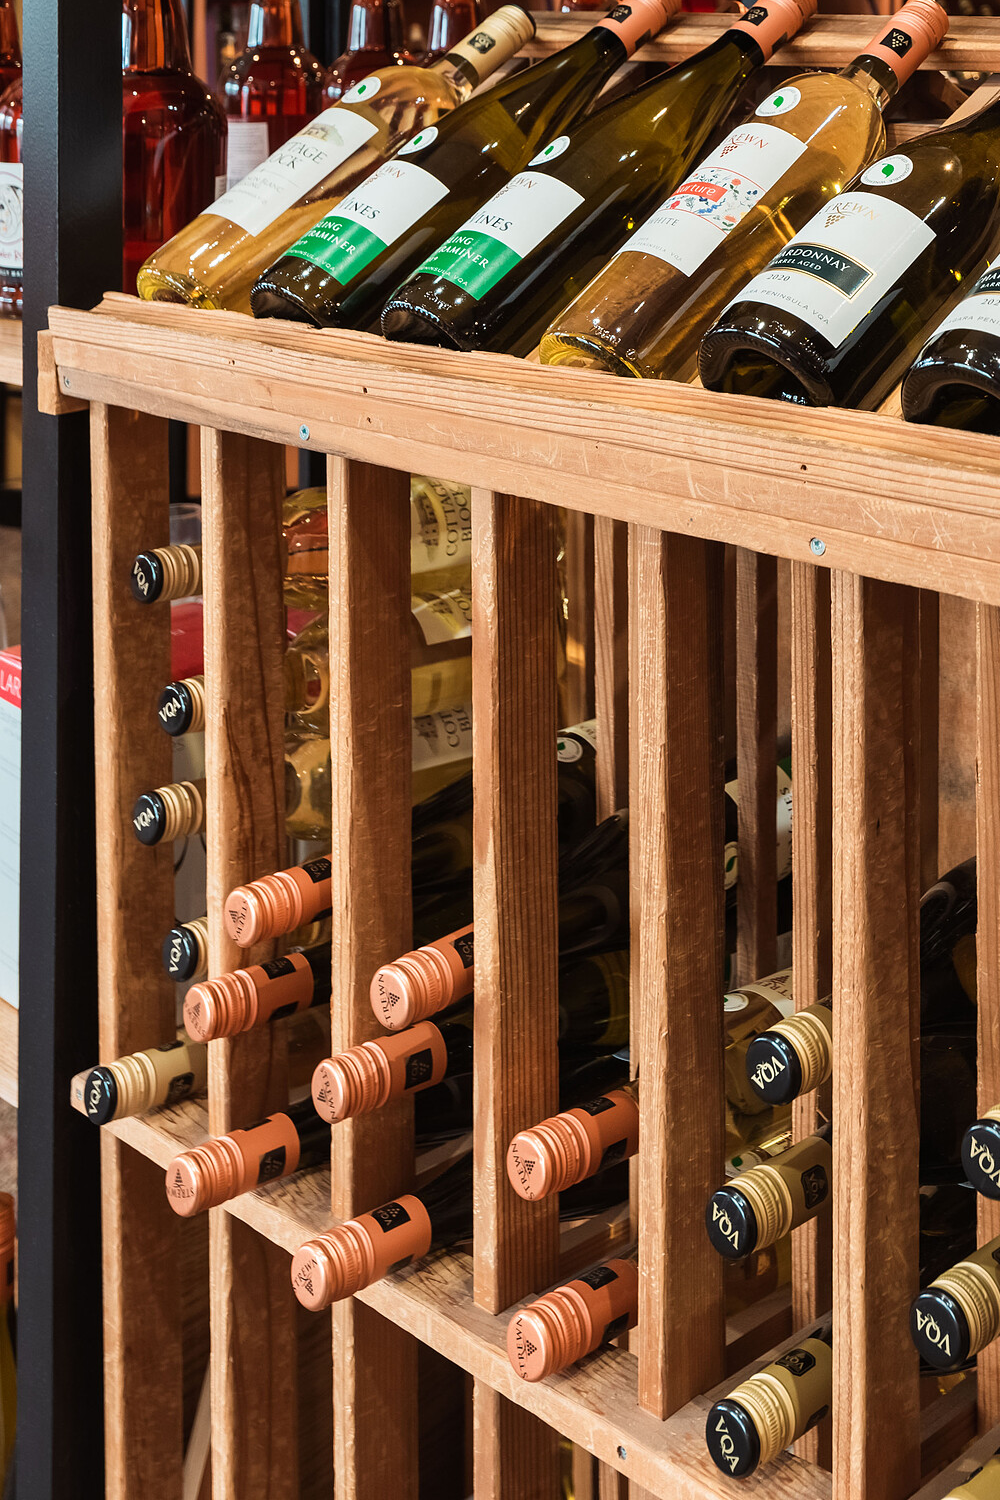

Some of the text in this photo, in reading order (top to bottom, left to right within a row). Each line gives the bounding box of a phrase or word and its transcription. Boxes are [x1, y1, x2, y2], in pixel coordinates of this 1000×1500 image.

[892, 31, 909, 46] VQA
[727, 133, 769, 150] REWN
[824, 201, 880, 221] TREWN
[766, 273, 791, 282] 2020
[777, 248, 850, 272] ARDONNAY
[798, 260, 822, 271] AGED
[761, 289, 809, 311] PENINSULA
[812, 310, 830, 325] VQA
[133, 561, 149, 596] VQA
[158, 697, 181, 723] VQA
[133, 807, 155, 831] VQA
[168, 937, 182, 973] VQA
[378, 973, 394, 1029] STREWN
[751, 1055, 786, 1090] VQA
[88, 1079, 102, 1115] VQA
[320, 1065, 338, 1121] STREWN
[512, 1143, 535, 1200] STREWN
[712, 1202, 739, 1250] VQA
[516, 1317, 528, 1379] STREWN
[916, 1308, 952, 1357] VQA
[715, 1415, 739, 1473] VQA
